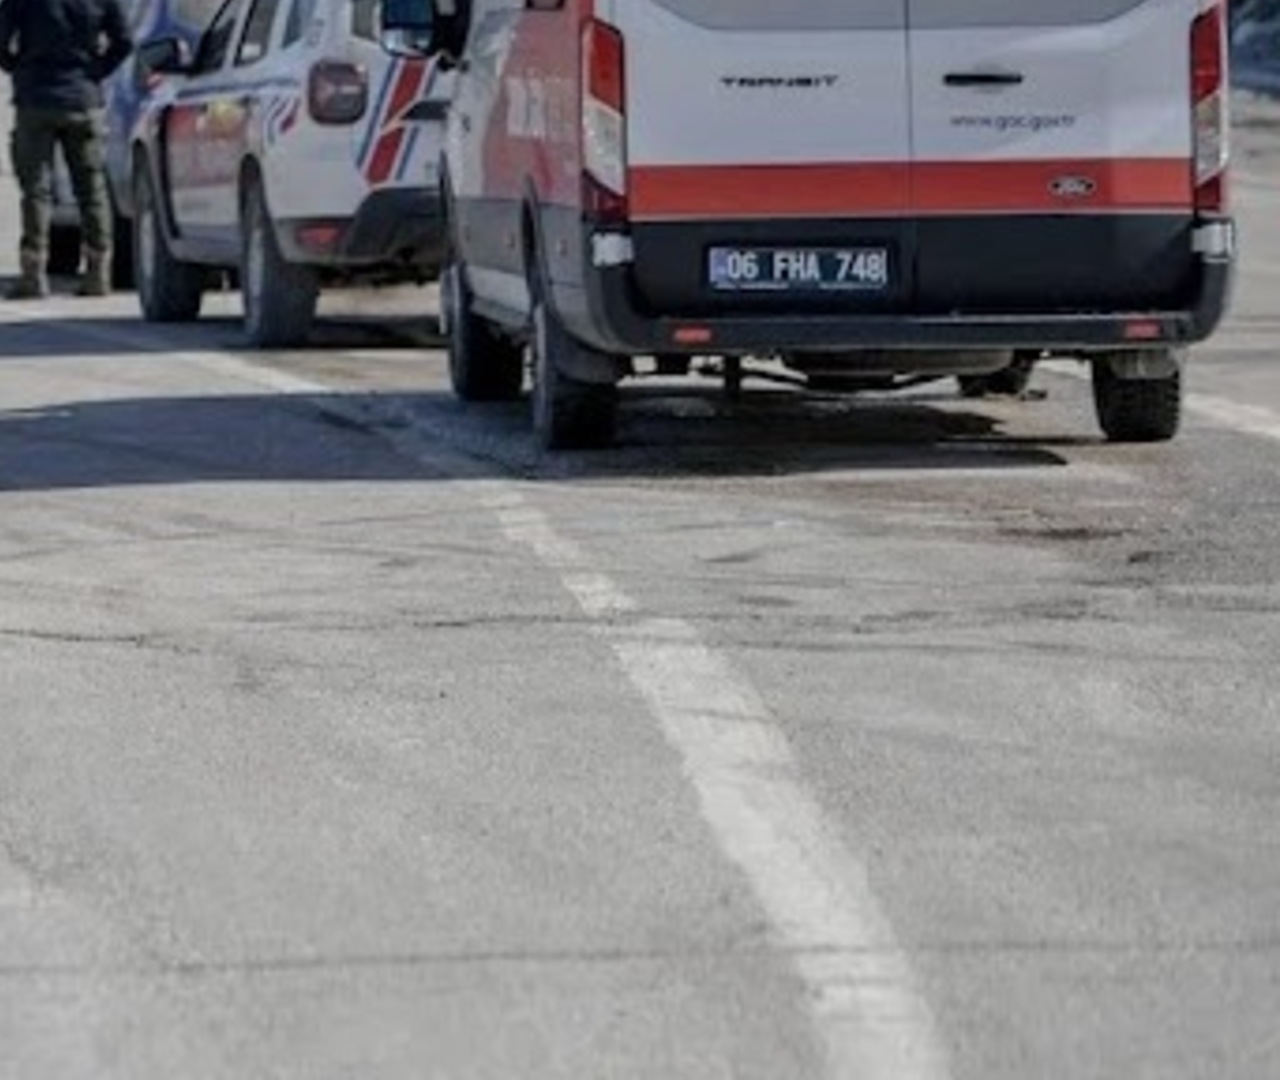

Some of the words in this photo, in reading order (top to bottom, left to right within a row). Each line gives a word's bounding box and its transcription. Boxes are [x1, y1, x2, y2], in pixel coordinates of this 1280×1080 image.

[728, 251, 759, 279] 06
[773, 250, 820, 281] FHA
[836, 250, 881, 282] 748
